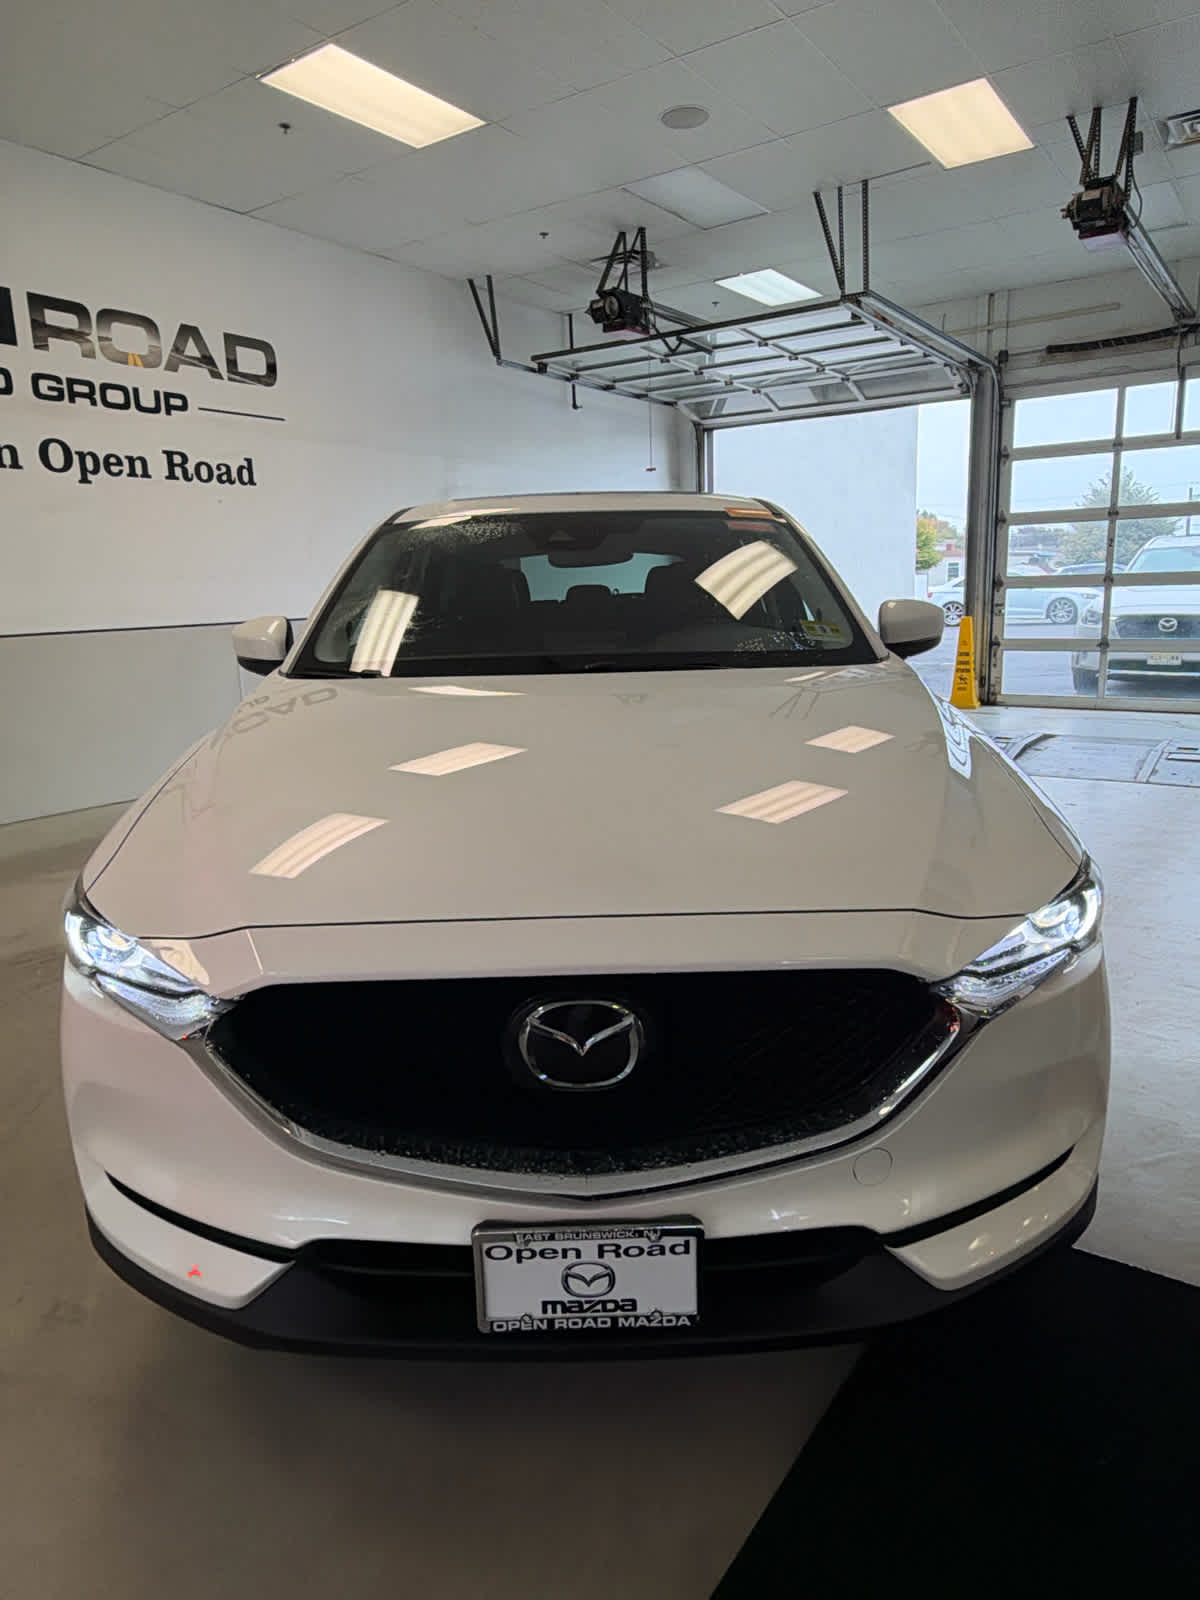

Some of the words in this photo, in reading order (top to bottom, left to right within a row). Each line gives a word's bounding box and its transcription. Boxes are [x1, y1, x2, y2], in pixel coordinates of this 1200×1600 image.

[26, 291, 278, 388] ROAD
[31, 372, 189, 416] GROUP
[38, 437, 152, 485] Open
[161, 449, 257, 487] Road
[484, 1245, 582, 1264] Open
[597, 1239, 691, 1260] Road
[492, 1318, 549, 1332] OPEN
[554, 1317, 612, 1330] ROAD
[618, 1314, 691, 1327] MAZDA
